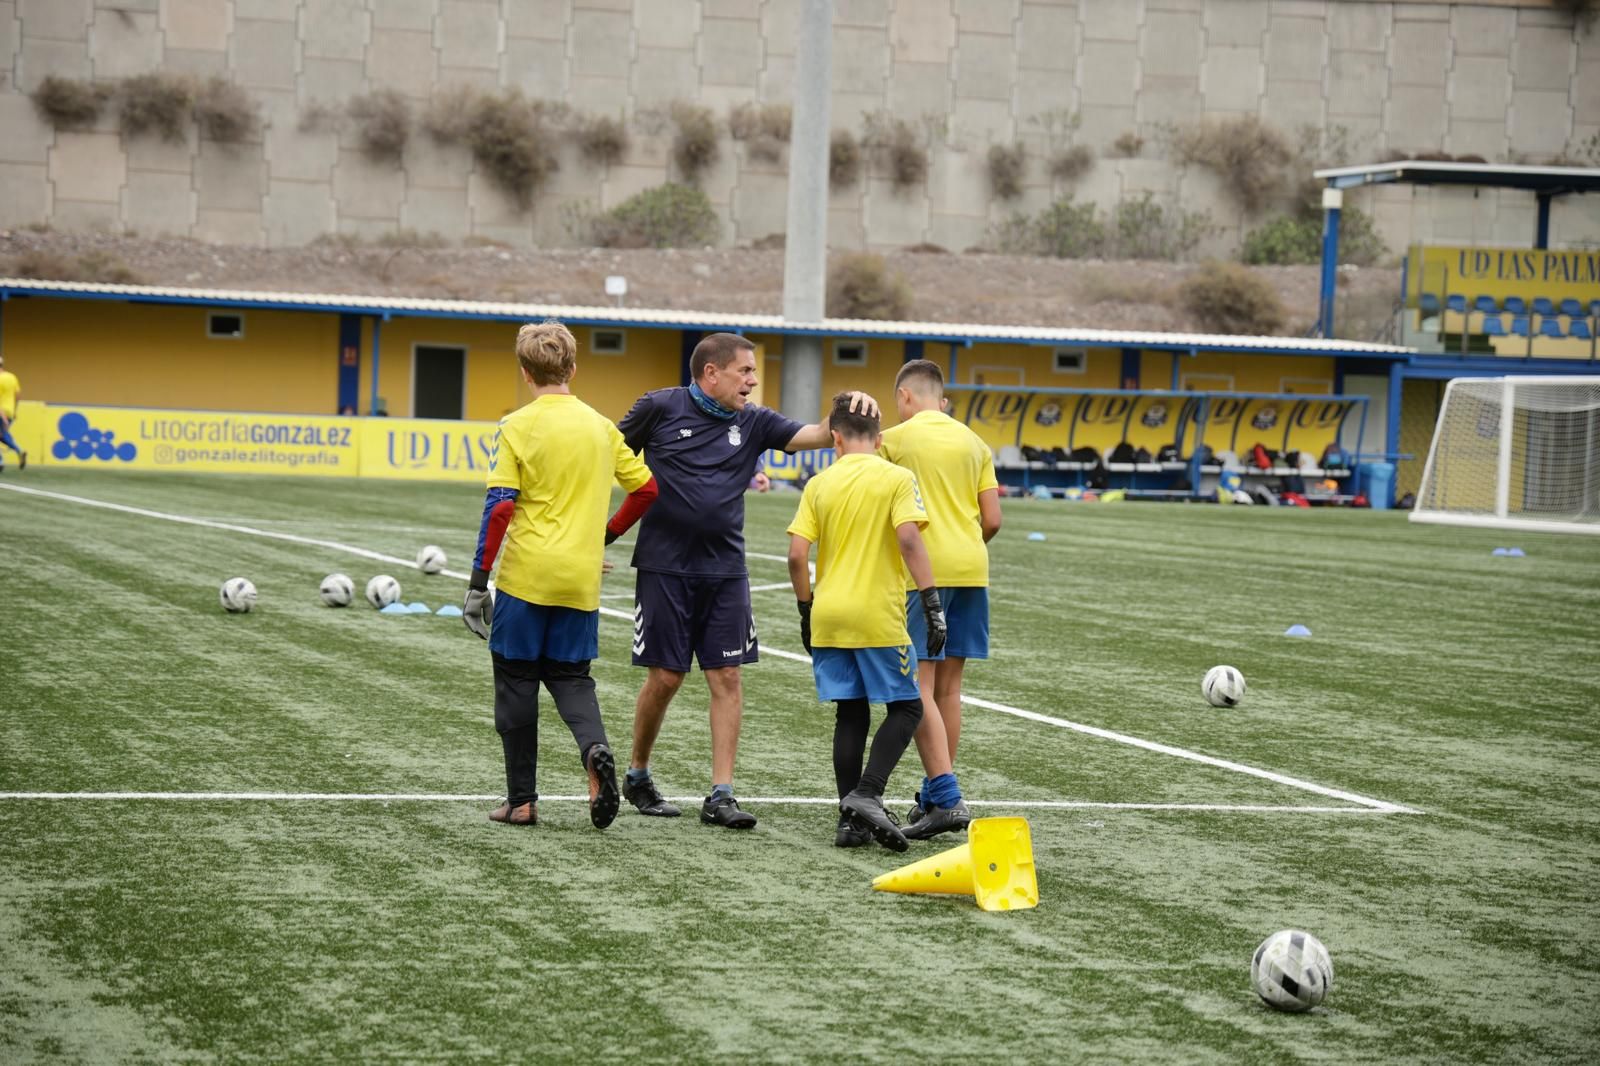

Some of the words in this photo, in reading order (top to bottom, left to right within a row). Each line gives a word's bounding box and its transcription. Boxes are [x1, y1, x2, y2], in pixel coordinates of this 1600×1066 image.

[1458, 250, 1491, 279] UD
[1497, 251, 1536, 281] LAS
[387, 431, 431, 469] UD
